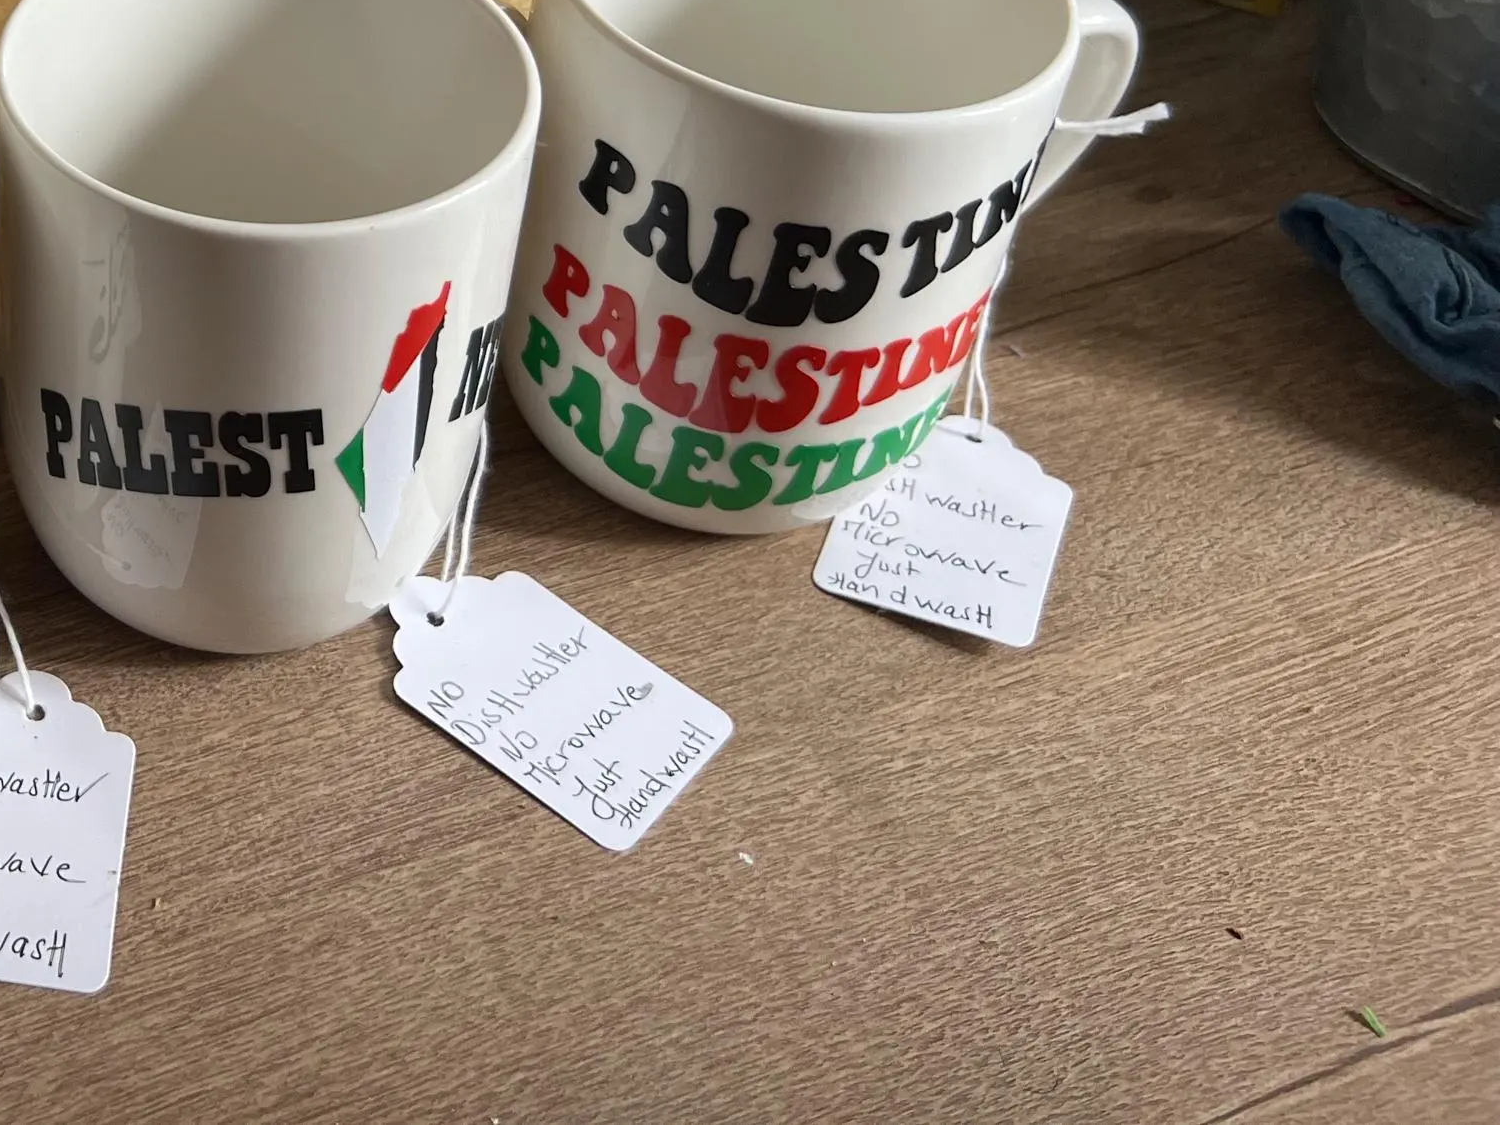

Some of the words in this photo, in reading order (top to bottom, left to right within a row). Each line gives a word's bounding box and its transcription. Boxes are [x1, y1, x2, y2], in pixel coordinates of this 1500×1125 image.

[578, 119, 1057, 327] PALESTIN
[842, 519, 1027, 587] Microwave
[523, 683, 653, 785] Microwave
